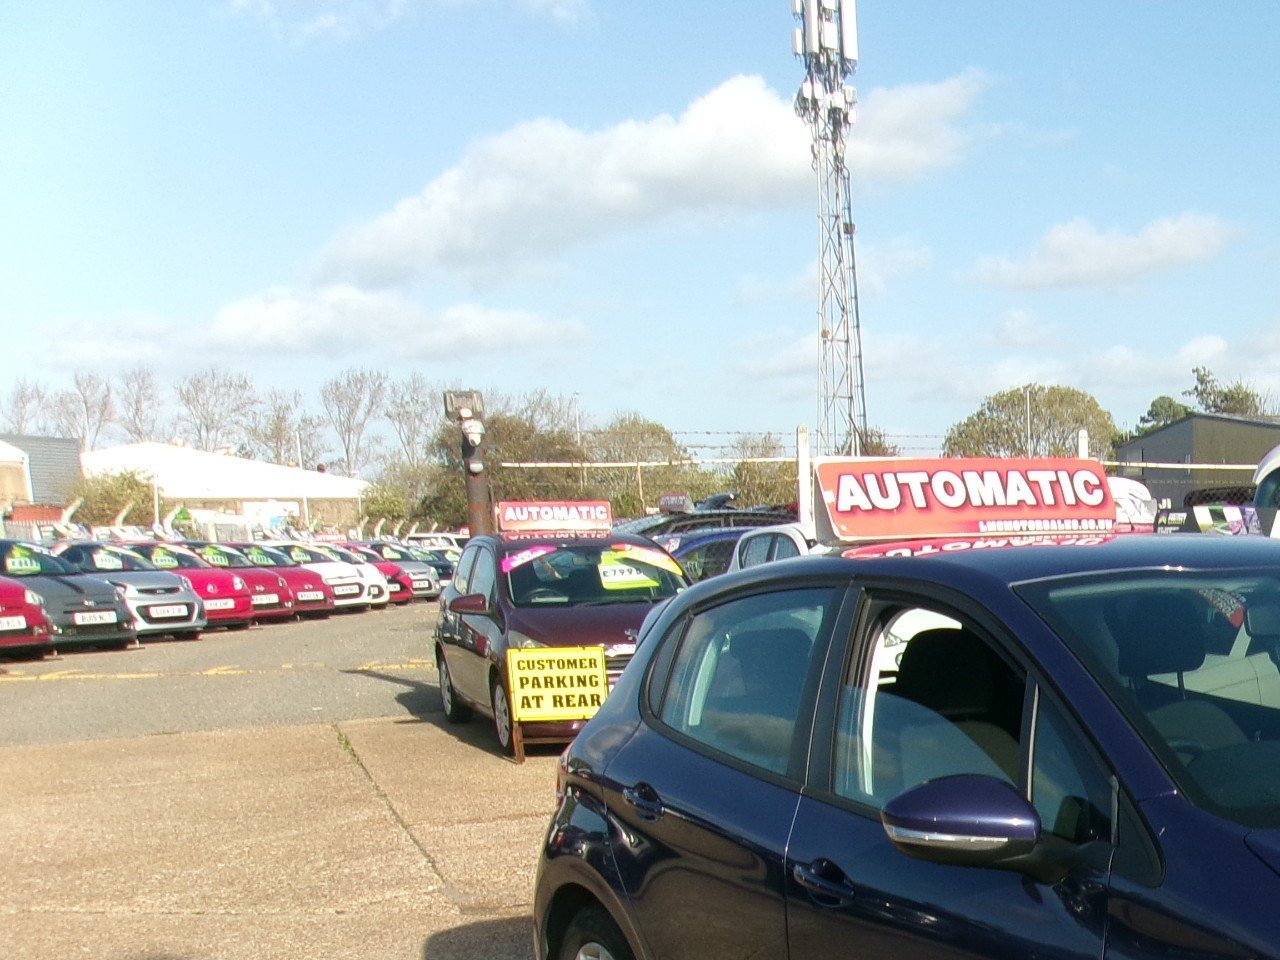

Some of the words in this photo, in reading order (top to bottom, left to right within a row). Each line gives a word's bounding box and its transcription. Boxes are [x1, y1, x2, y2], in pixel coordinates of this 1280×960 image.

[836, 470, 1104, 512] AUTOMATIC
[504, 505, 609, 522] AUTOMATIC
[517, 658, 598, 671] CUSTOMER
[519, 675, 599, 689] PARKING
[521, 695, 544, 709] AT
[553, 694, 601, 708] REAR
